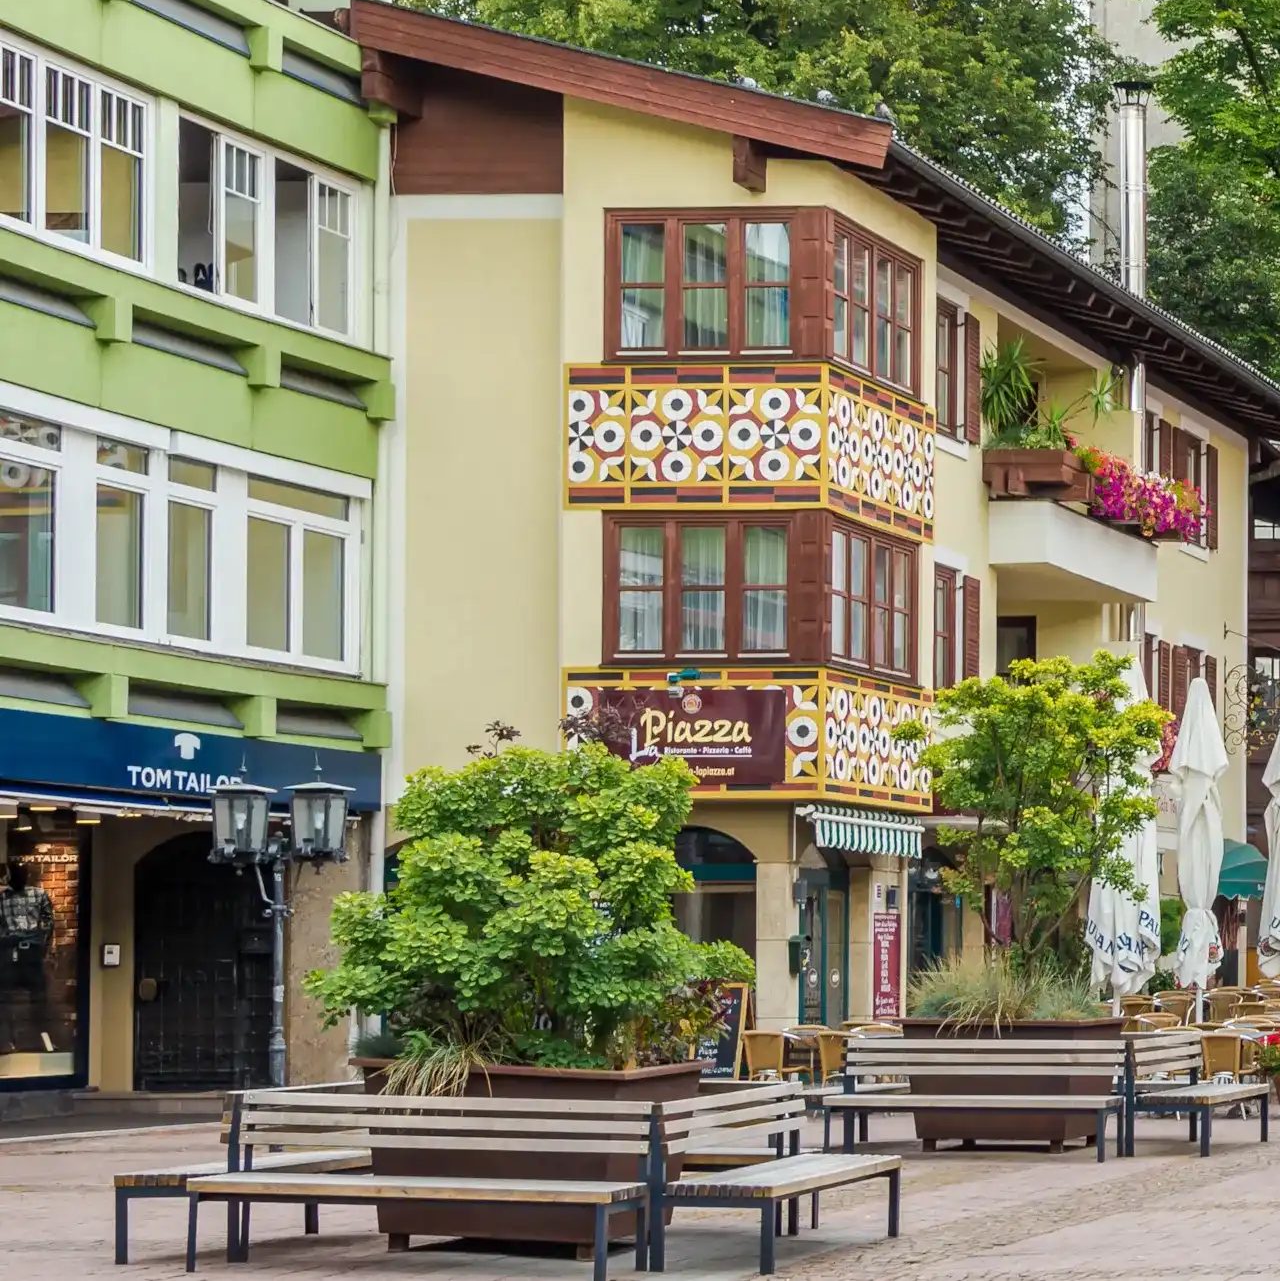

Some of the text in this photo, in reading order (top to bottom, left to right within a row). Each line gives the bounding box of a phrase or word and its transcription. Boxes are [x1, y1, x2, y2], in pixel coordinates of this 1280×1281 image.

[640, 707, 752, 746] Piazza
[702, 746, 730, 754] Pizzeria
[127, 766, 172, 789] TOM
[35, 854, 78, 863] TAILOR
